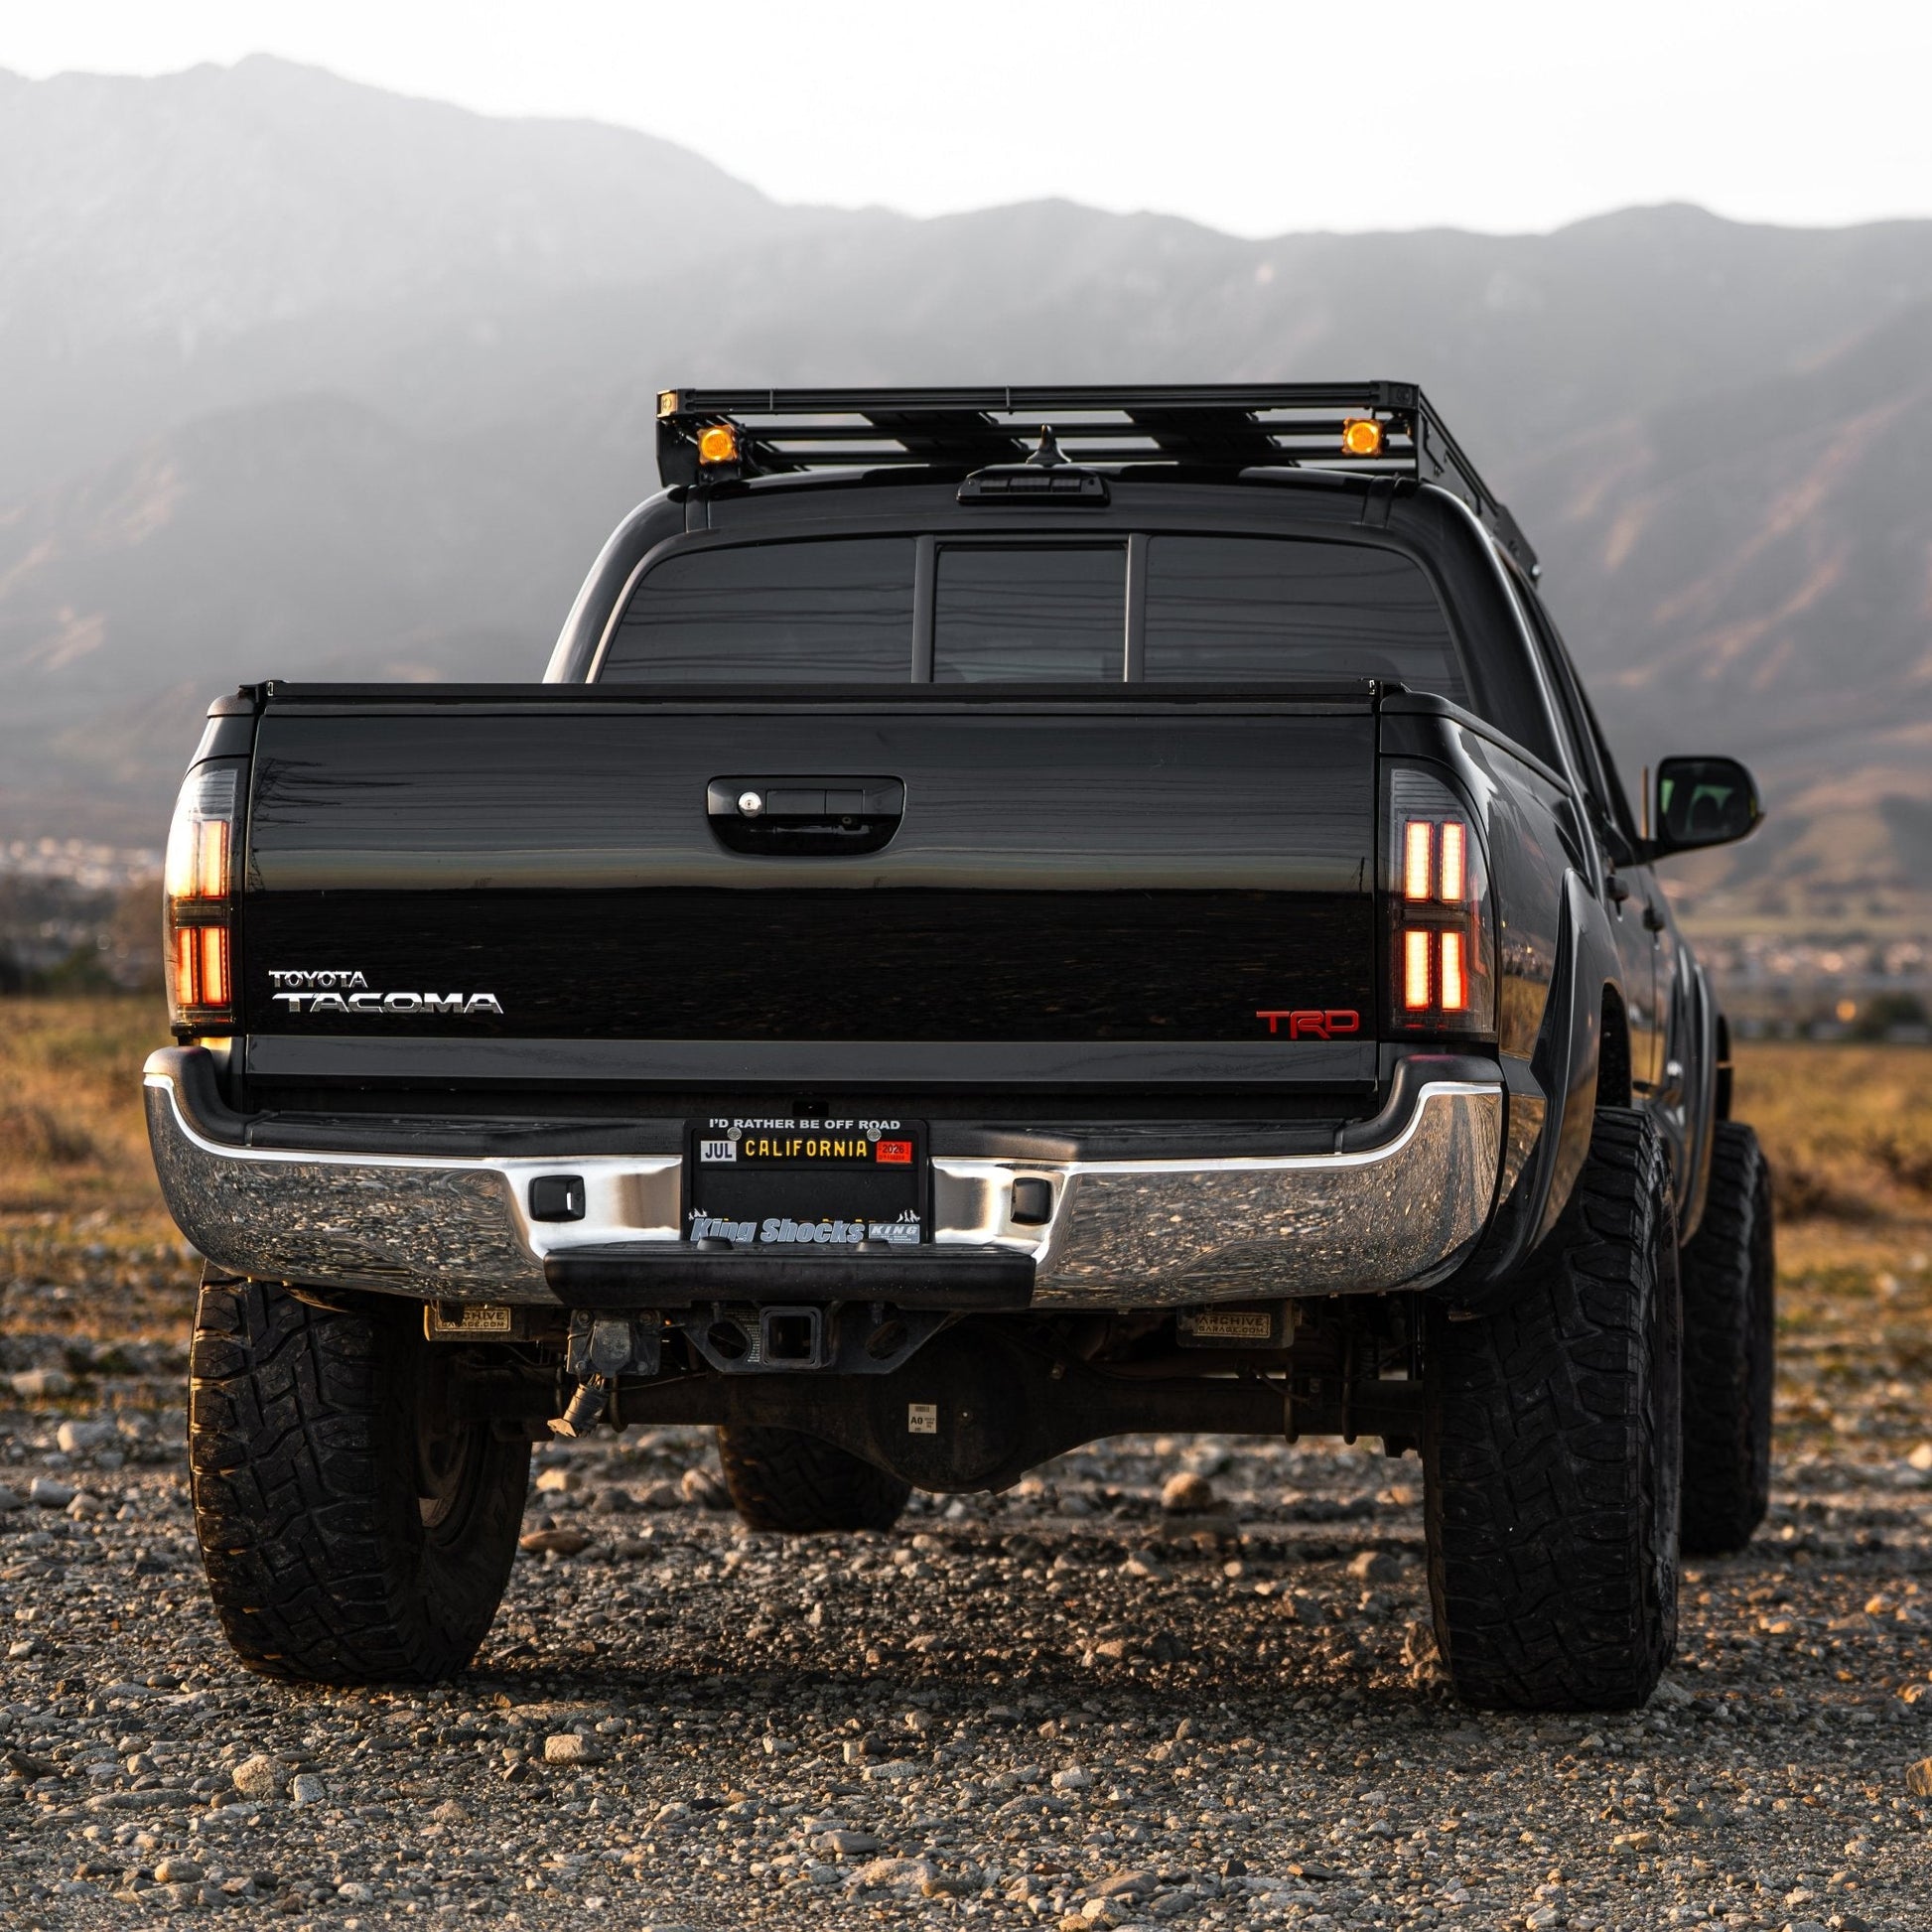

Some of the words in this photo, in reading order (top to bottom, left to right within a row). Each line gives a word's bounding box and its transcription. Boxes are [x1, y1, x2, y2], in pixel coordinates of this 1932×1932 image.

[268, 970, 368, 989] TOYOTA
[272, 992, 504, 1015] TACOMA
[1255, 1010, 1359, 1039] TRD
[709, 1118, 729, 1128] I'D
[733, 1119, 794, 1129] RATHER
[799, 1119, 820, 1129] BE
[824, 1119, 854, 1129] OFF
[859, 1120, 900, 1130] ROAD
[705, 1142, 733, 1159] JUL
[745, 1139, 868, 1158] CALIFORNIA
[882, 1144, 905, 1154] 2026
[690, 1218, 757, 1243] King
[759, 1218, 865, 1243] Shocks
[871, 1225, 918, 1235] KING
[1198, 1315, 1263, 1326] ARCHIVE
